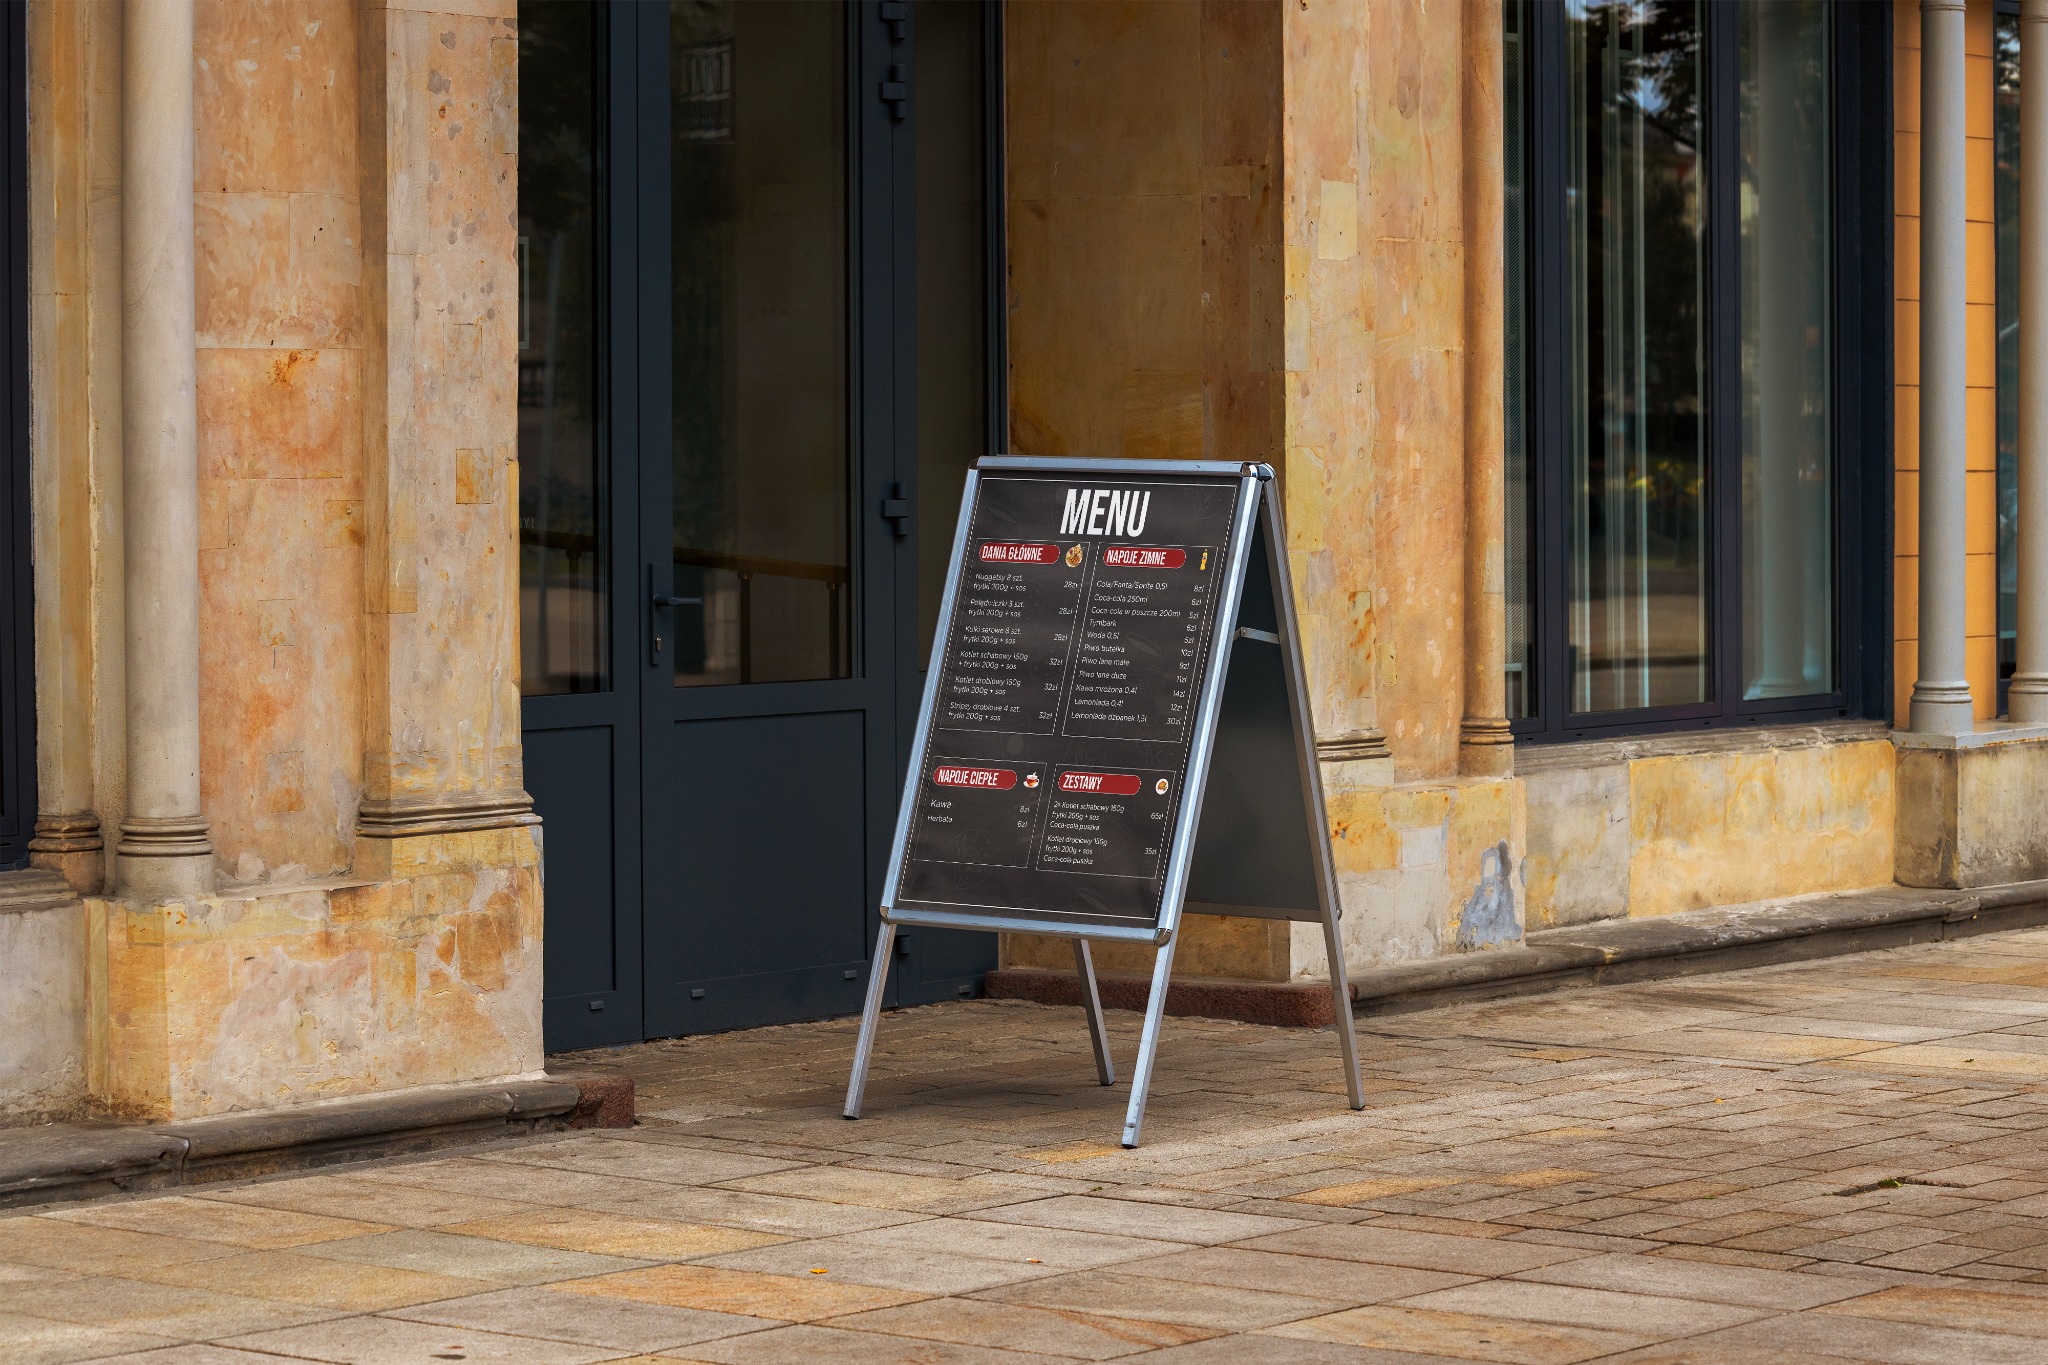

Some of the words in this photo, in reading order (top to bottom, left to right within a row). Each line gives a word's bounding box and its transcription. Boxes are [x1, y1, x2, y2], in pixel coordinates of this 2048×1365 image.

[1060, 489, 1150, 537] MENU
[982, 546, 1007, 560] DANIA
[1008, 545, 1042, 561] GŁÓWNE
[1106, 550, 1137, 564] NAPOJE
[1138, 551, 1166, 566] ZIMNE
[938, 770, 969, 784] NAPOJE
[970, 771, 999, 786] CIEPŁE
[1063, 775, 1103, 789] ZESTAWY
[930, 800, 952, 809] Kawa
[928, 815, 952, 823] Herbata
